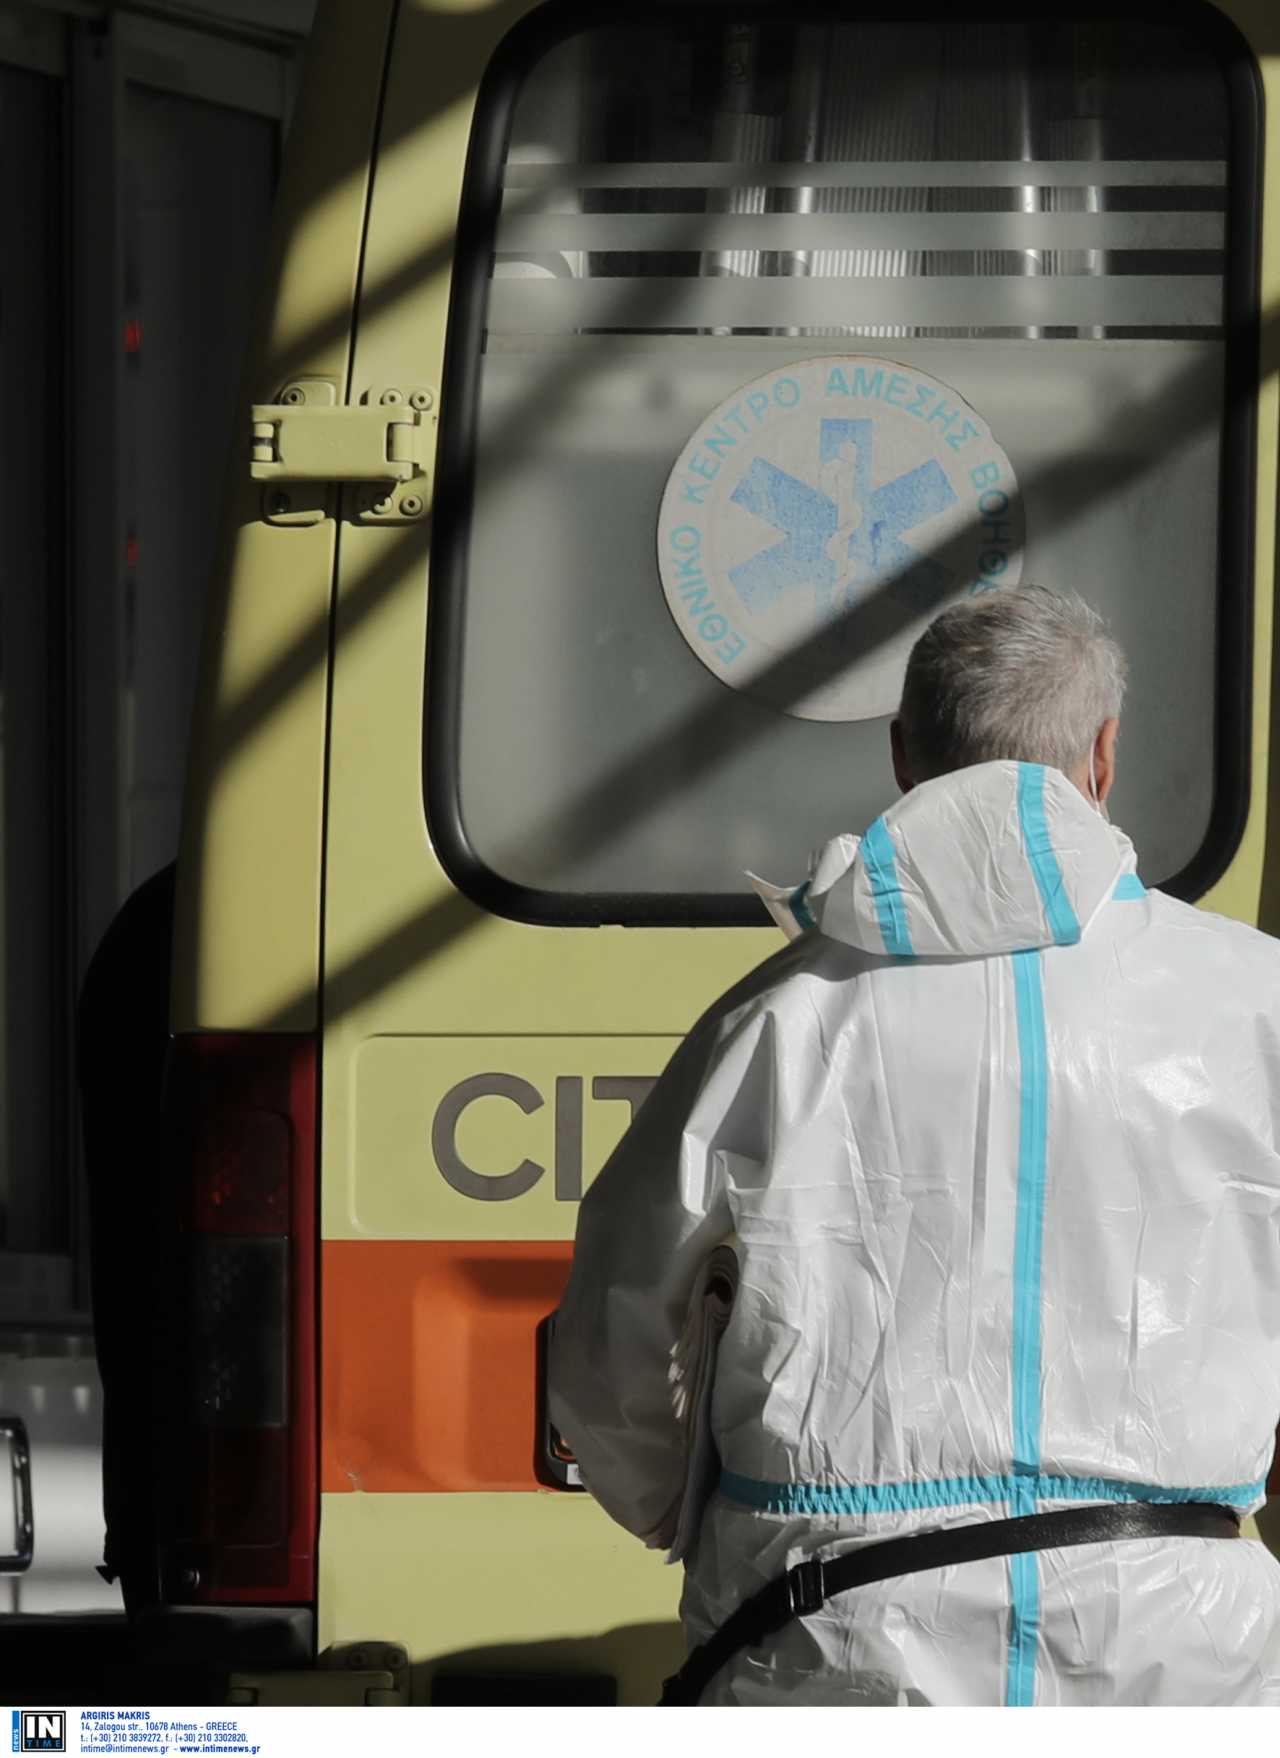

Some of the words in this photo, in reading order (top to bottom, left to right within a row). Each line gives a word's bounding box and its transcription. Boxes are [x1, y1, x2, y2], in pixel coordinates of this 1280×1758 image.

[682, 377, 801, 506] ΚΕΝΤΡΟ
[826, 366, 982, 453] ΑΜΕΣΗΣ
[671, 524, 748, 665] ΕΘΝΙΚΟ
